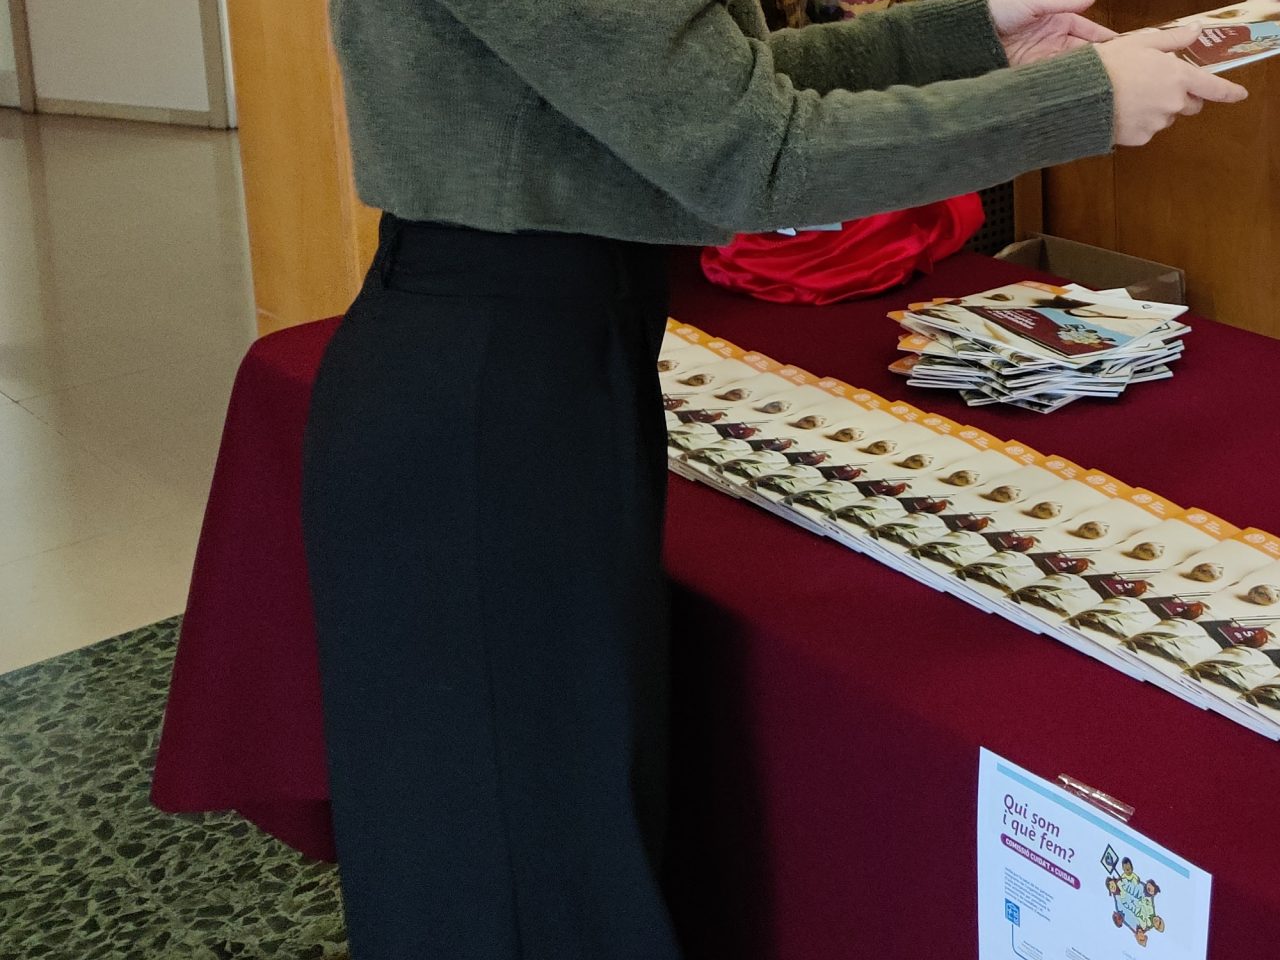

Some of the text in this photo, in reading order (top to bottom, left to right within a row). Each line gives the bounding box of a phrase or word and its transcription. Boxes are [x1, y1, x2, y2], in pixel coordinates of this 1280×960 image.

[1003, 794, 1060, 838] Qui som
[1003, 809, 1075, 863] i què fem?
[1005, 838, 1030, 857] COMISSIÓ
[1055, 867, 1075, 886] CUIDAR
